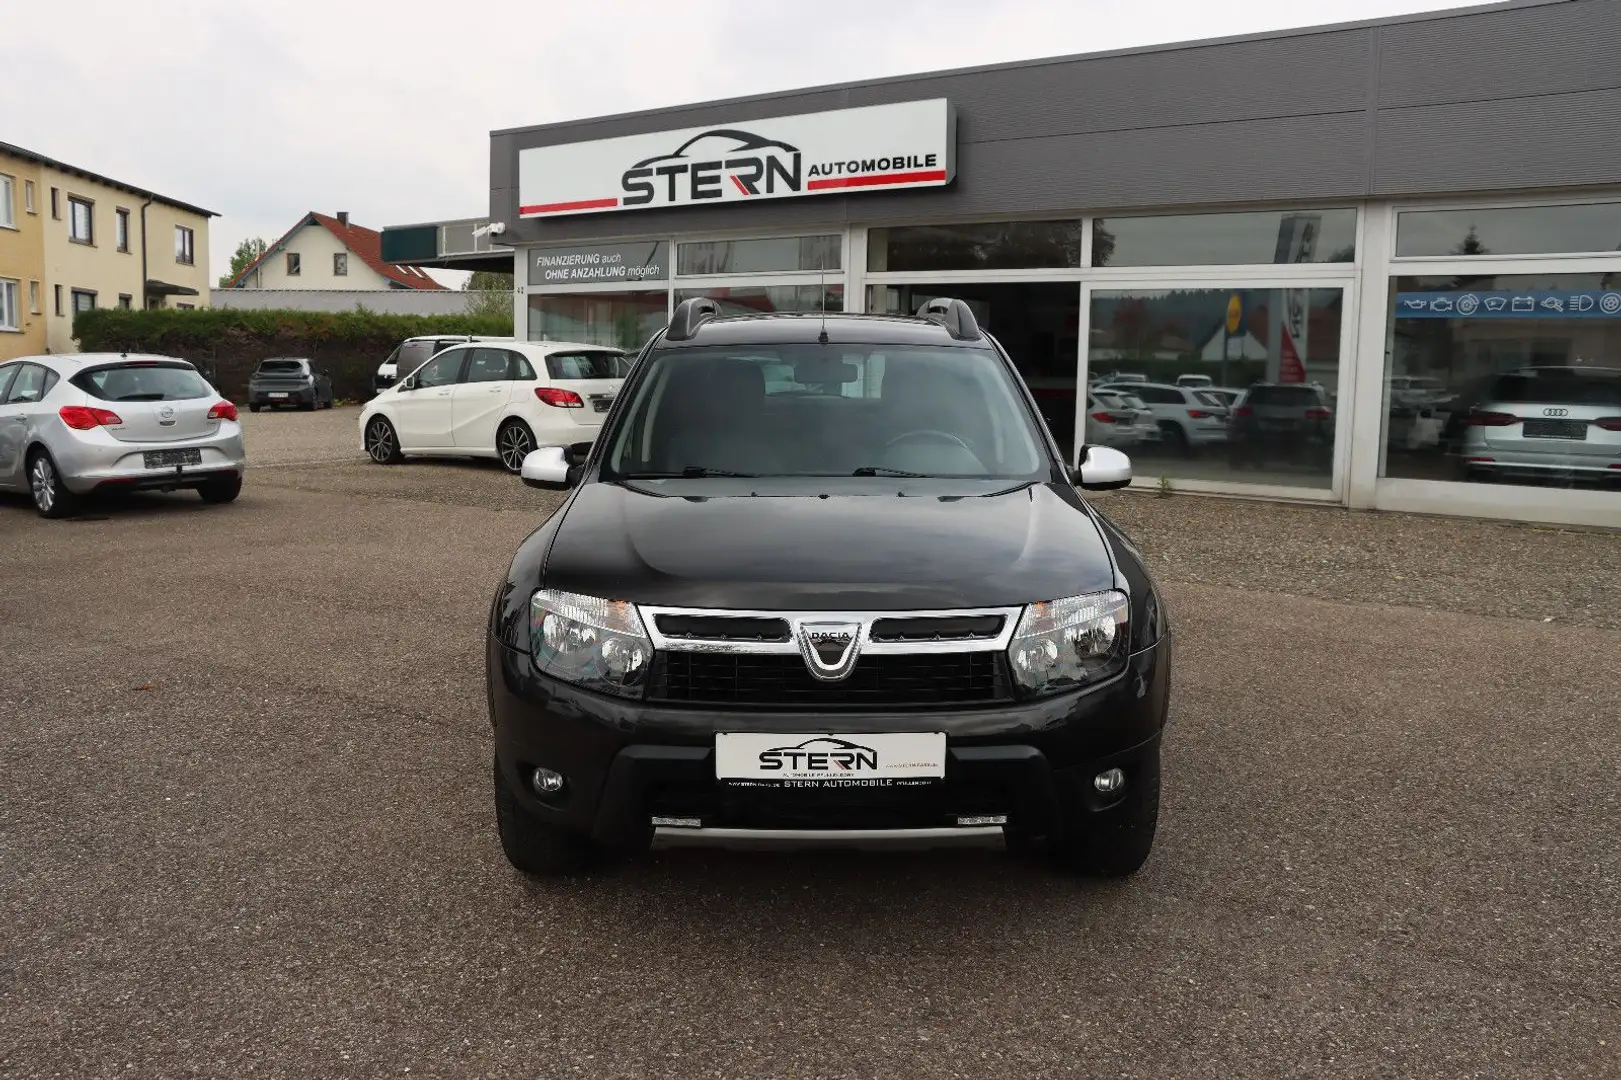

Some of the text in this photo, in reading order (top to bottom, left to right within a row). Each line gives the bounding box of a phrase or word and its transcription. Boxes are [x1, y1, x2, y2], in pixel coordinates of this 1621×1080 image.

[621, 151, 938, 206] STERN AUTOMOBILE
[536, 252, 622, 268] FINANZIERUNG auch
[544, 264, 660, 280] OHNE ANZAHLUNG möglich
[811, 632, 850, 640] DACIA
[759, 751, 878, 770] STERN
[784, 780, 819, 788] STERN
[822, 779, 893, 788] AUTOMOBILE
